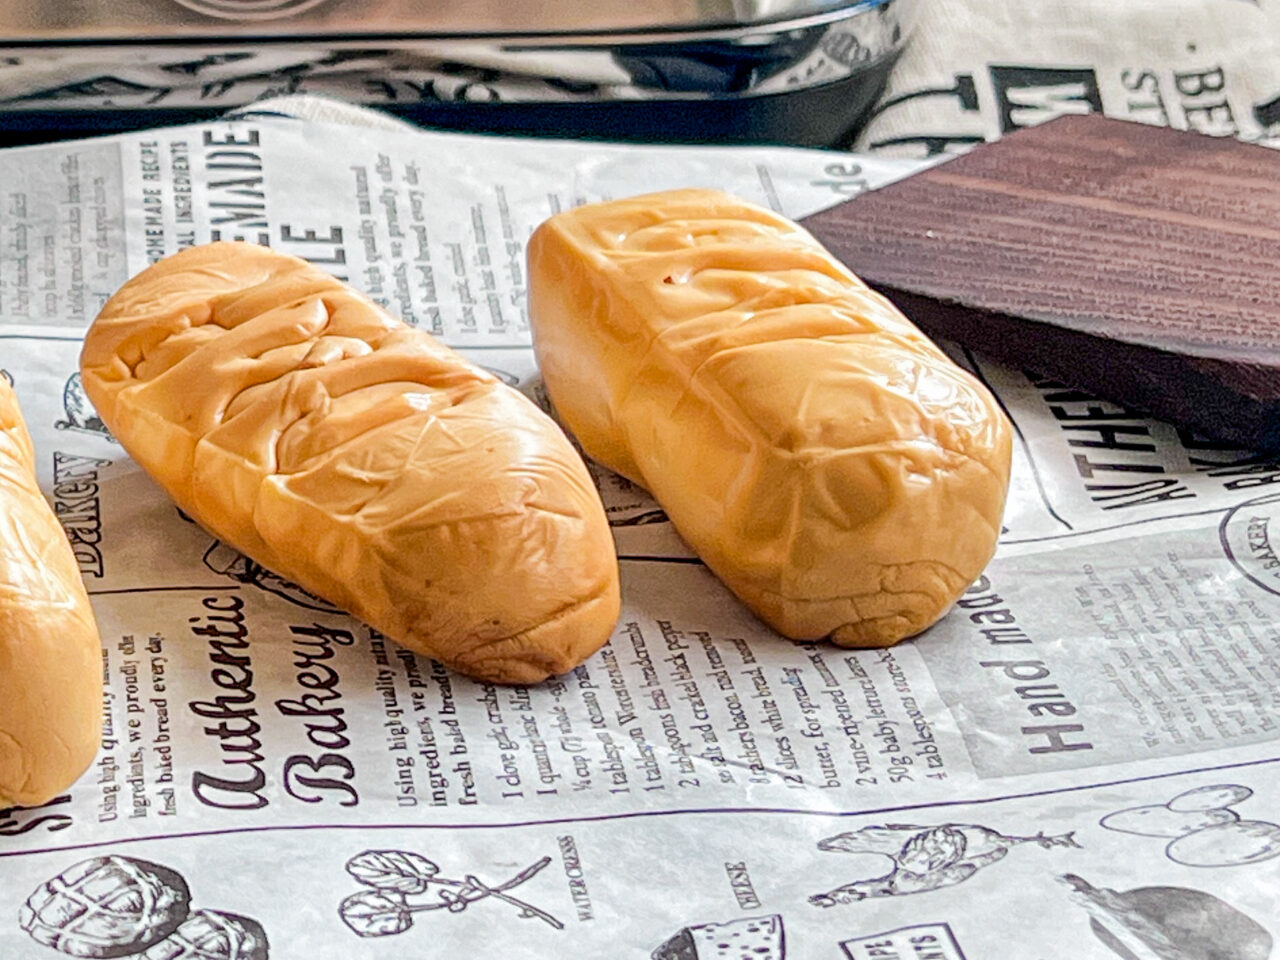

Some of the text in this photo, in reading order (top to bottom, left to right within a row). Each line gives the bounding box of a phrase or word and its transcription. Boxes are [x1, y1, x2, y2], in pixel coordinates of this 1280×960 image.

[139, 141, 160, 182] RECIPE
[170, 141, 194, 223] INGREDIENTS
[119, 660, 145, 714] proudly
[149, 657, 167, 692] every
[373, 669, 400, 718] quality
[149, 698, 170, 743] bread
[187, 593, 270, 811] Authentic
[274, 621, 359, 808] Bakery
[409, 691, 426, 712] we
[978, 659, 1094, 755] Hand
[126, 718, 142, 743] we
[801, 716, 825, 739] for
[872, 720, 901, 753] baby
[393, 756, 418, 808] Using
[453, 761, 478, 806] fresh
[677, 779, 701, 787] 2
[855, 777, 878, 786] 2
[886, 756, 914, 783] 50g
[926, 772, 948, 780] 4
[98, 785, 120, 823] Using
